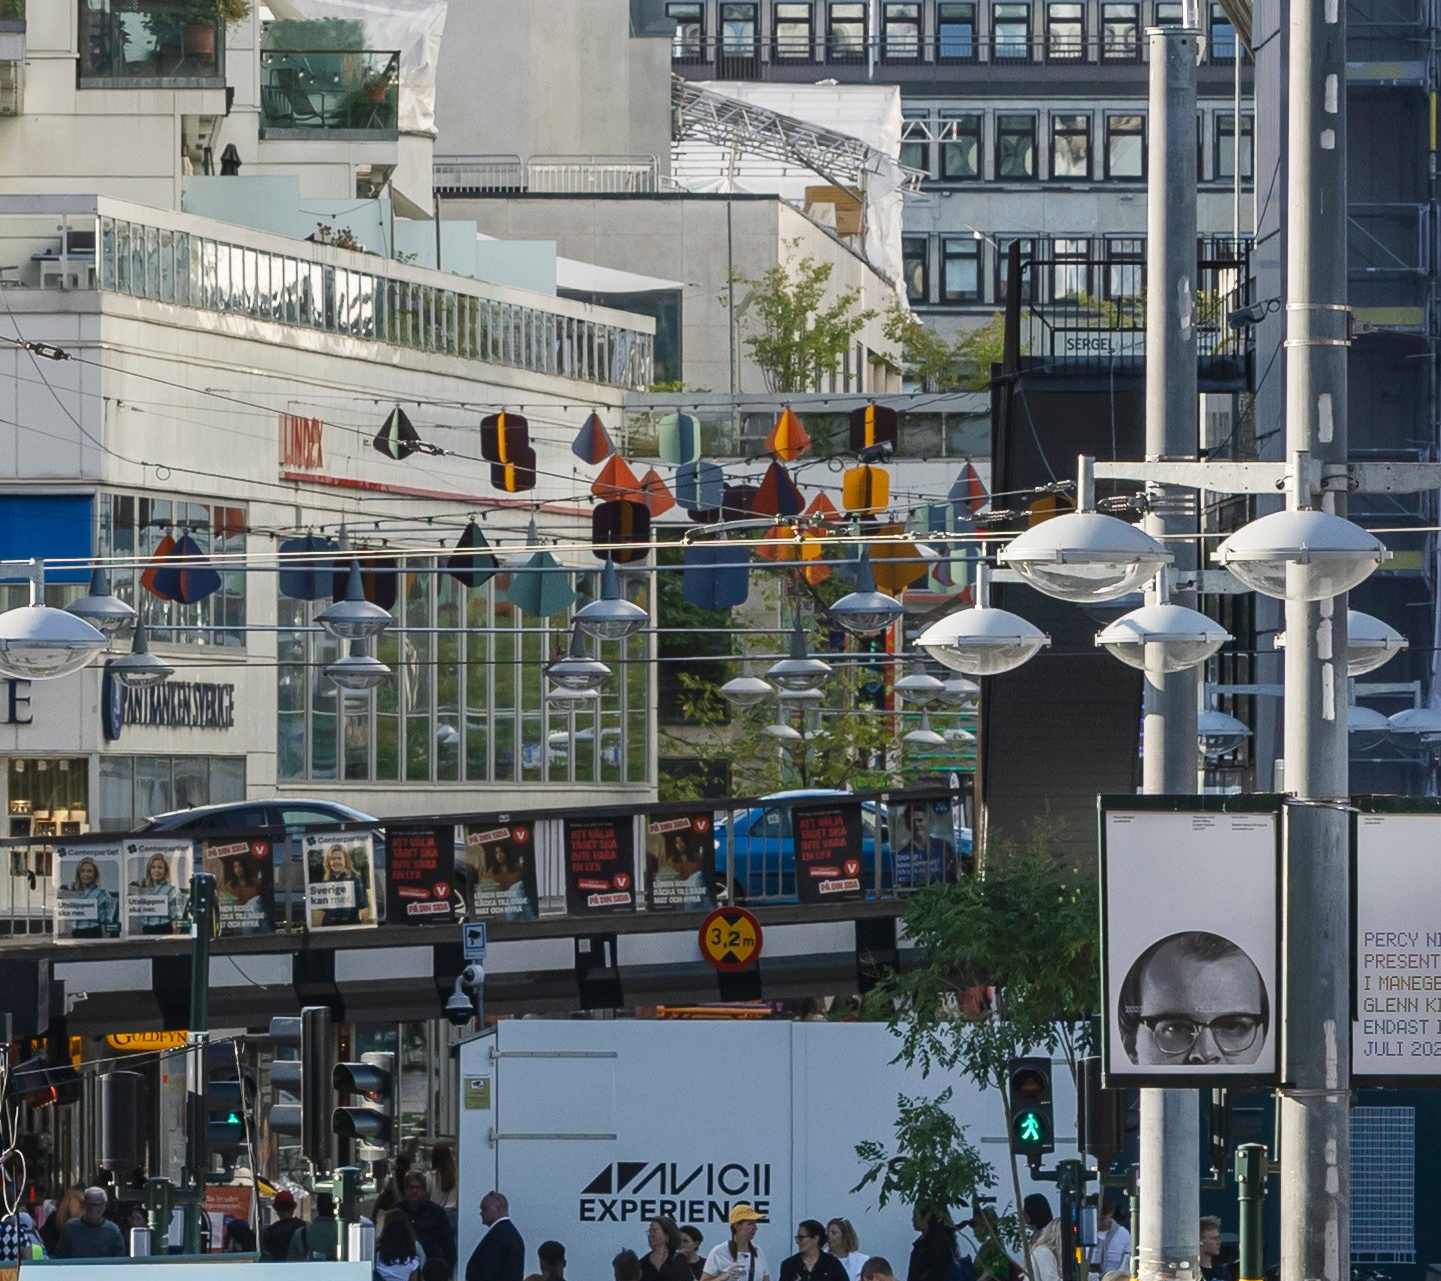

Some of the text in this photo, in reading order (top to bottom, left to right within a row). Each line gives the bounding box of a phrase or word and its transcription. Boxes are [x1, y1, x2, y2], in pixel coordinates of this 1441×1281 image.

[1067, 338, 1114, 351] SERGEL
[697, 821, 707, 830] V
[516, 831, 525, 840] V
[255, 846, 264, 855] V
[847, 863, 857, 874] V
[617, 877, 627, 886] V
[310, 884, 347, 896] Sverige
[435, 886, 447, 897] V
[310, 896, 329, 905] kan
[711, 927, 755, 949] 3,2 m
[1364, 932, 1419, 947] PERCY
[1364, 975, 1372, 991] I
[1363, 997, 1419, 1013] GLENN
[1363, 1019, 1428, 1034] ENDAST
[113, 1031, 187, 1045] GULDFYN
[1363, 1041, 1404, 1057] JULI
[632, 1162, 771, 1196] AVICII
[579, 1198, 771, 1224] EXPERIENE
